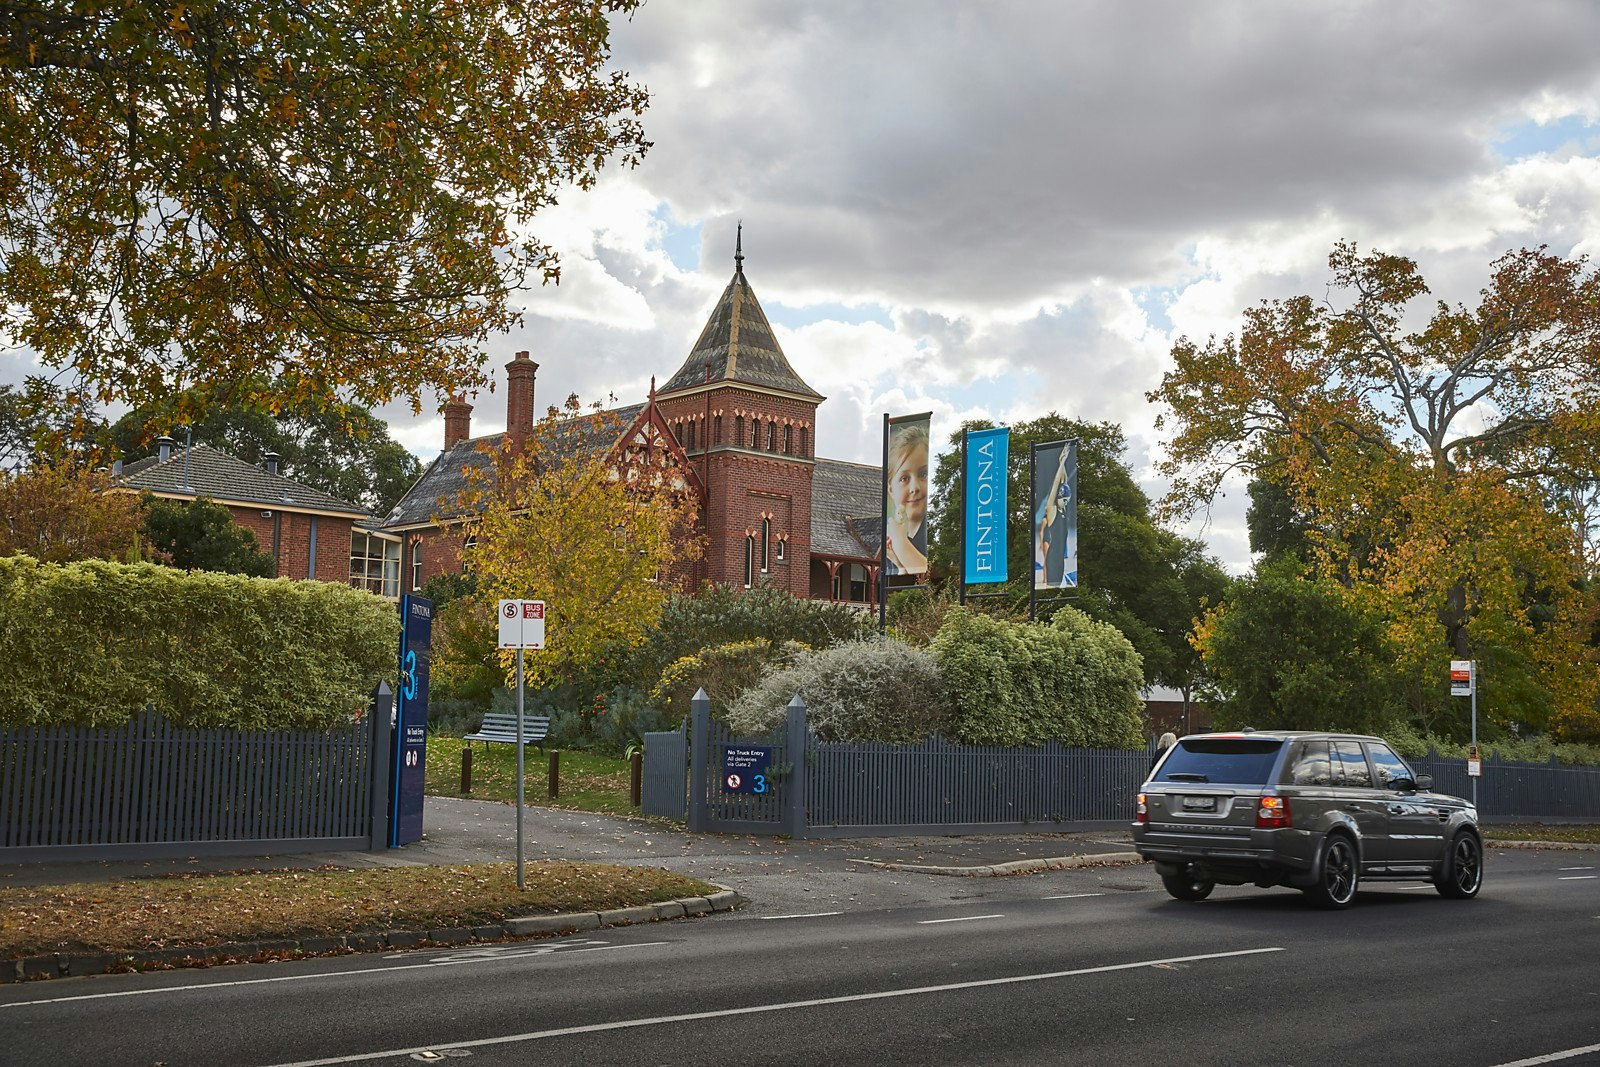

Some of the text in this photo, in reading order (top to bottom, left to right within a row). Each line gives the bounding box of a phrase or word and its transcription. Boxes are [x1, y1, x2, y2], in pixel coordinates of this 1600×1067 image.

[977, 439, 994, 572] FINTONA
[402, 650, 416, 700] 3
[754, 775, 765, 792] 3
